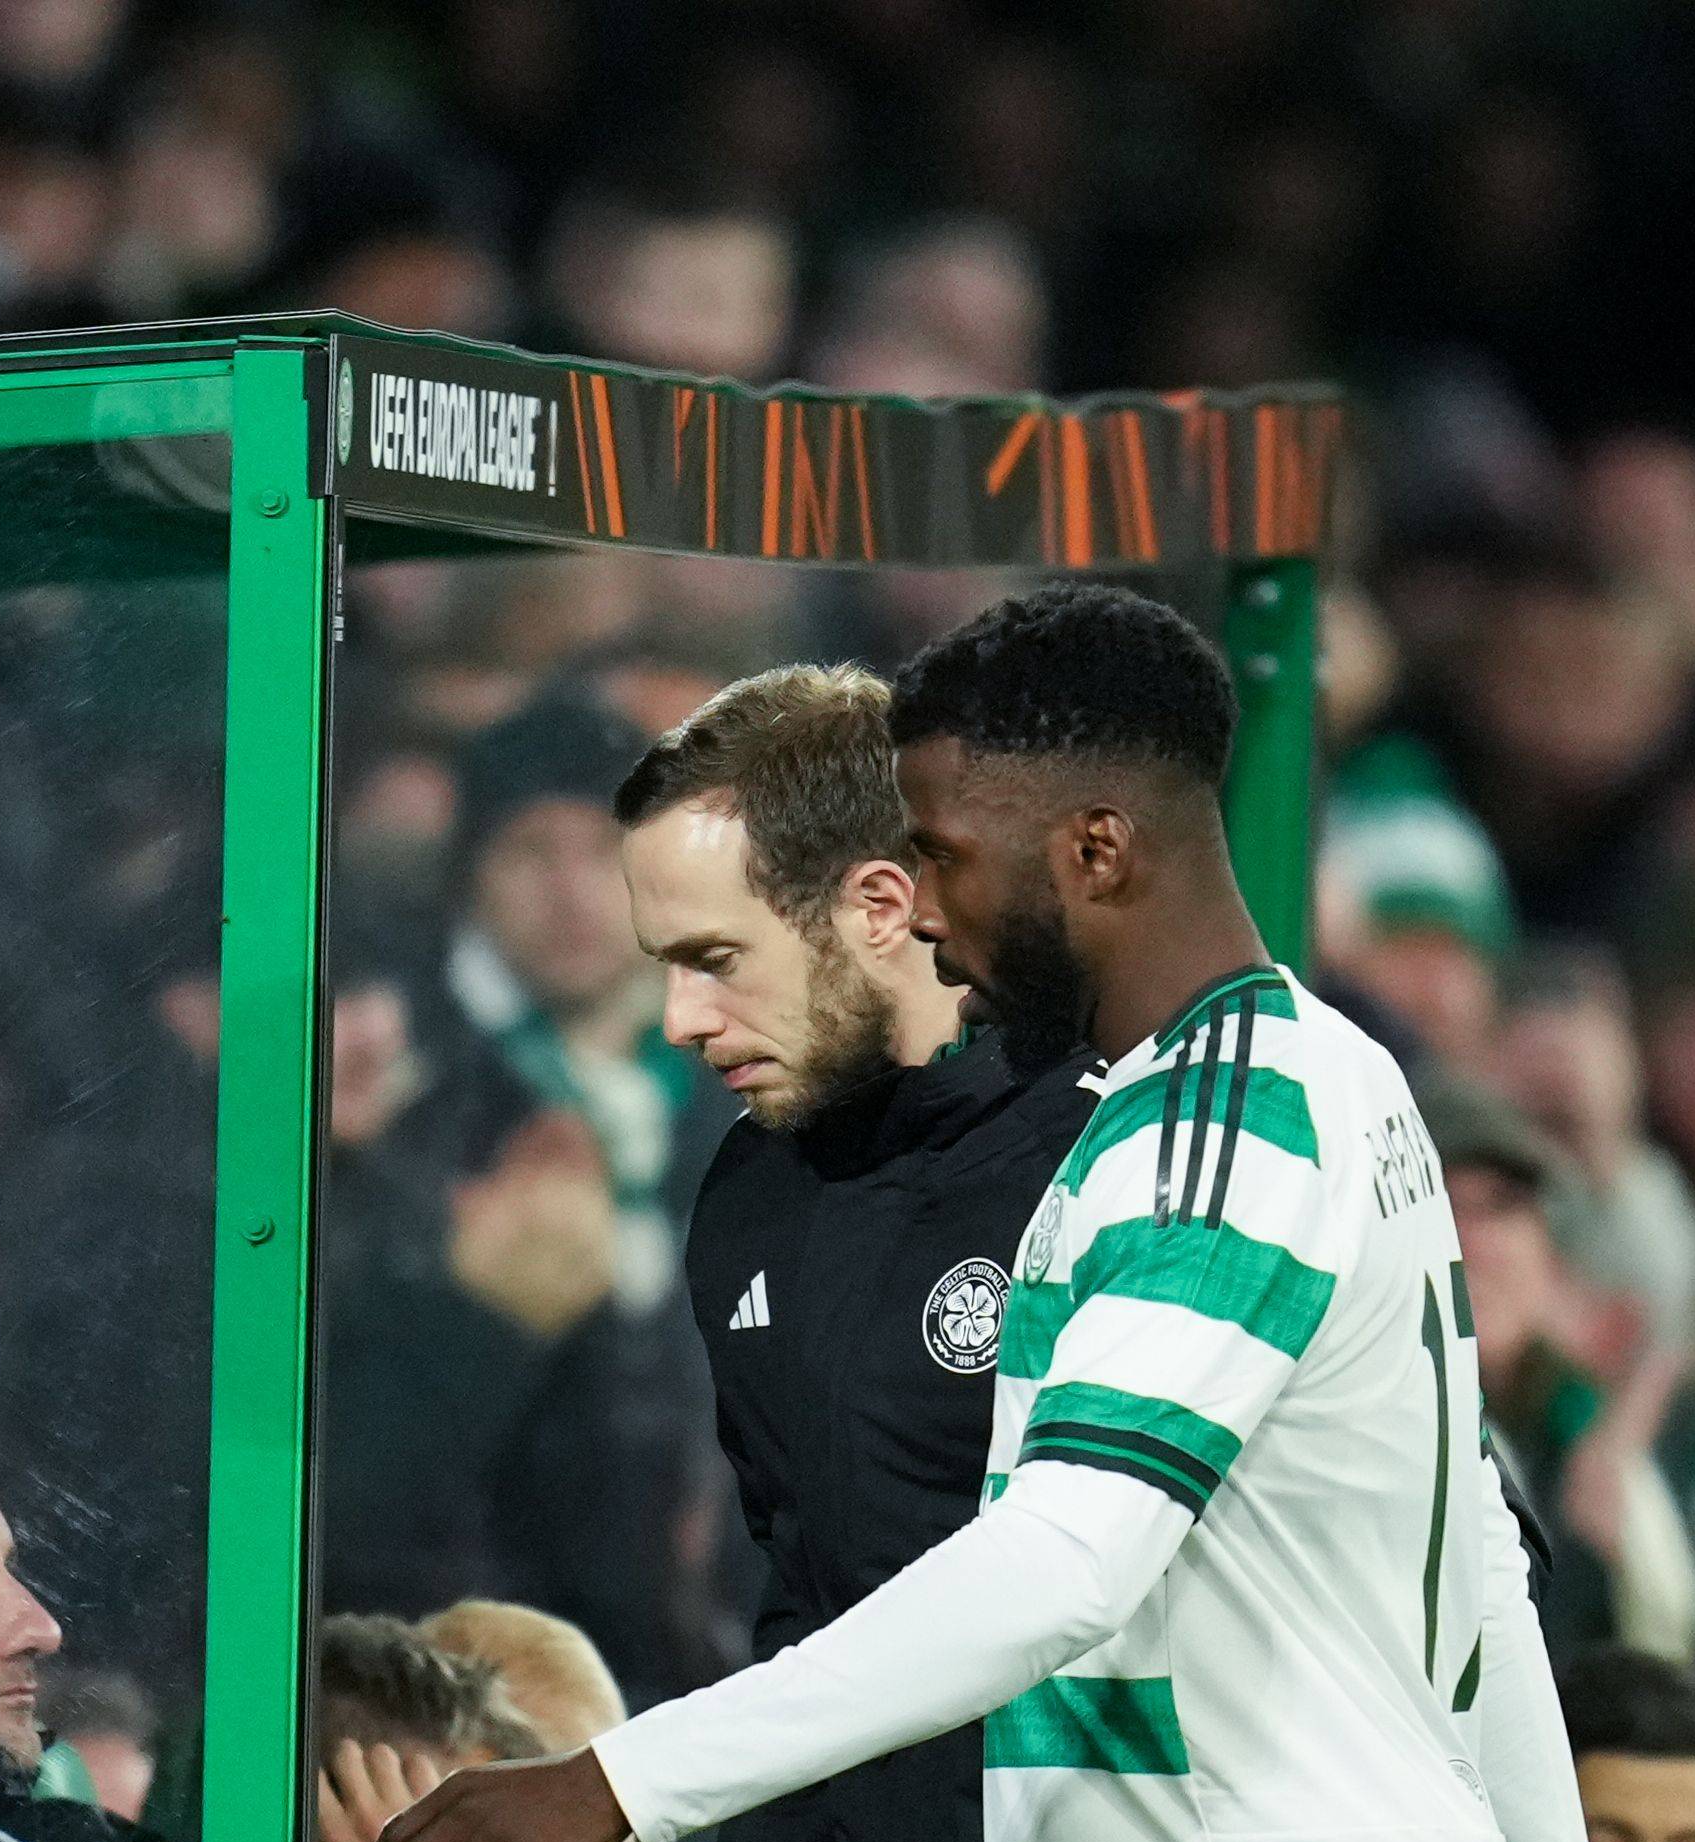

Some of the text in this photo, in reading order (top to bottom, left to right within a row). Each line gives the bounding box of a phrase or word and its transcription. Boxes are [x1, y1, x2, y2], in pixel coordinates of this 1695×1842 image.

[370, 372, 537, 492] UEFA EUROPA LEAGUE
[929, 1263, 1002, 1315] THE CELTIC FOOTBALL
